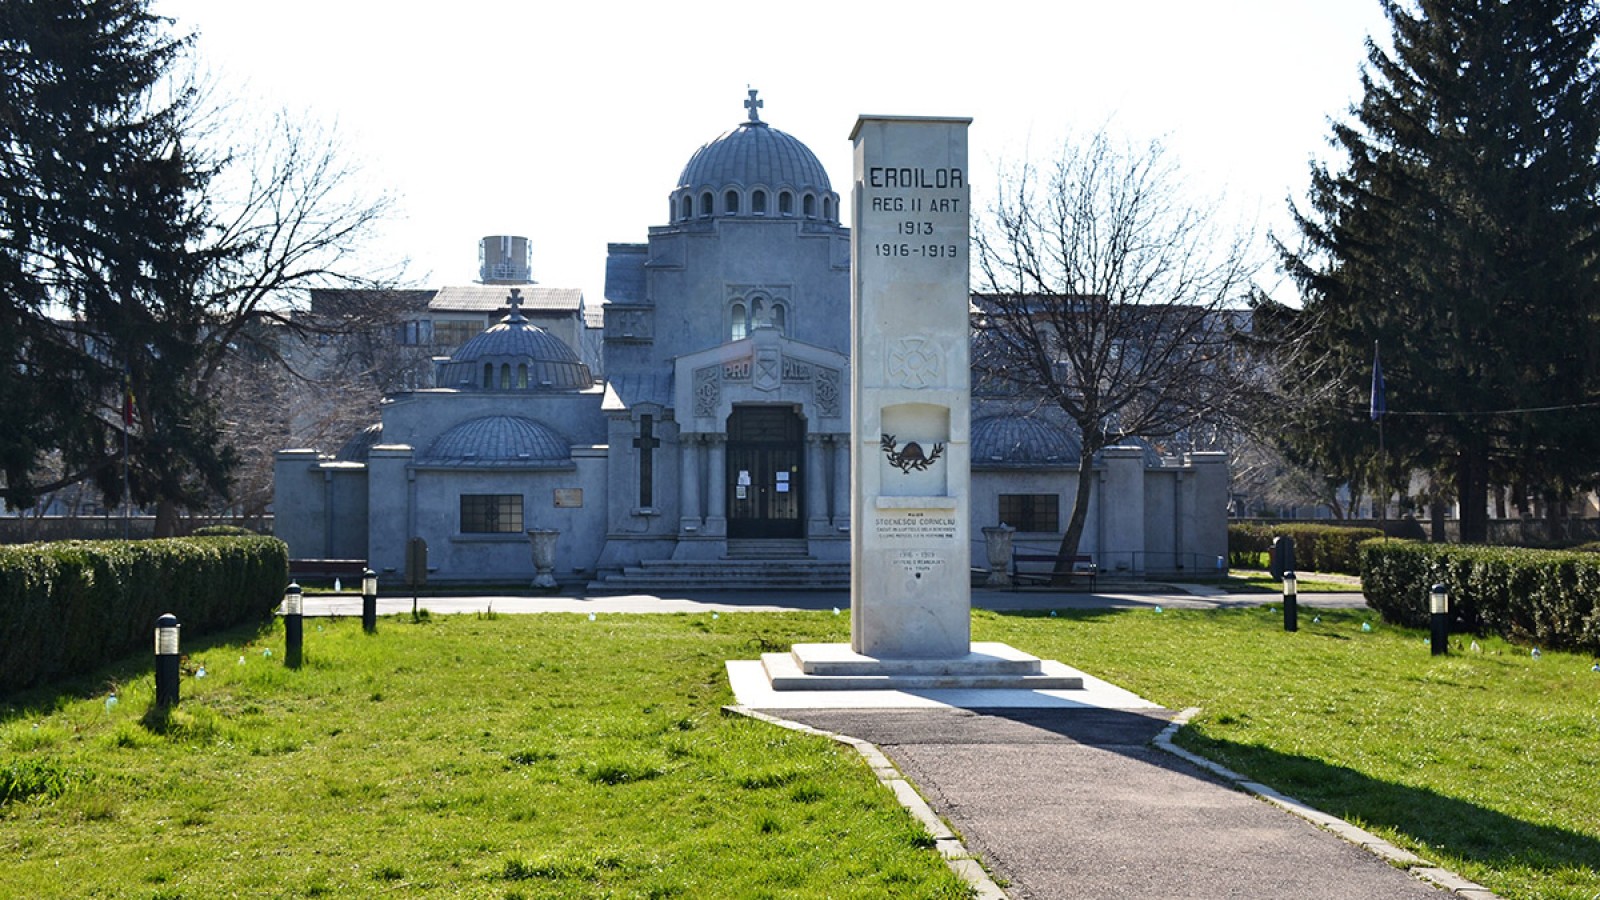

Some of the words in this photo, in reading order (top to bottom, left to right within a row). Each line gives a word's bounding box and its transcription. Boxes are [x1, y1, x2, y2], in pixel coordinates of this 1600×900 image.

[870, 167, 962, 189] EROILOR
[872, 197, 907, 212] REG.
[929, 198, 963, 213] ART.
[898, 221, 934, 235] 1913
[875, 243, 957, 258] 1916-1919
[723, 362, 750, 378] PRO
[783, 359, 811, 378] PAT
